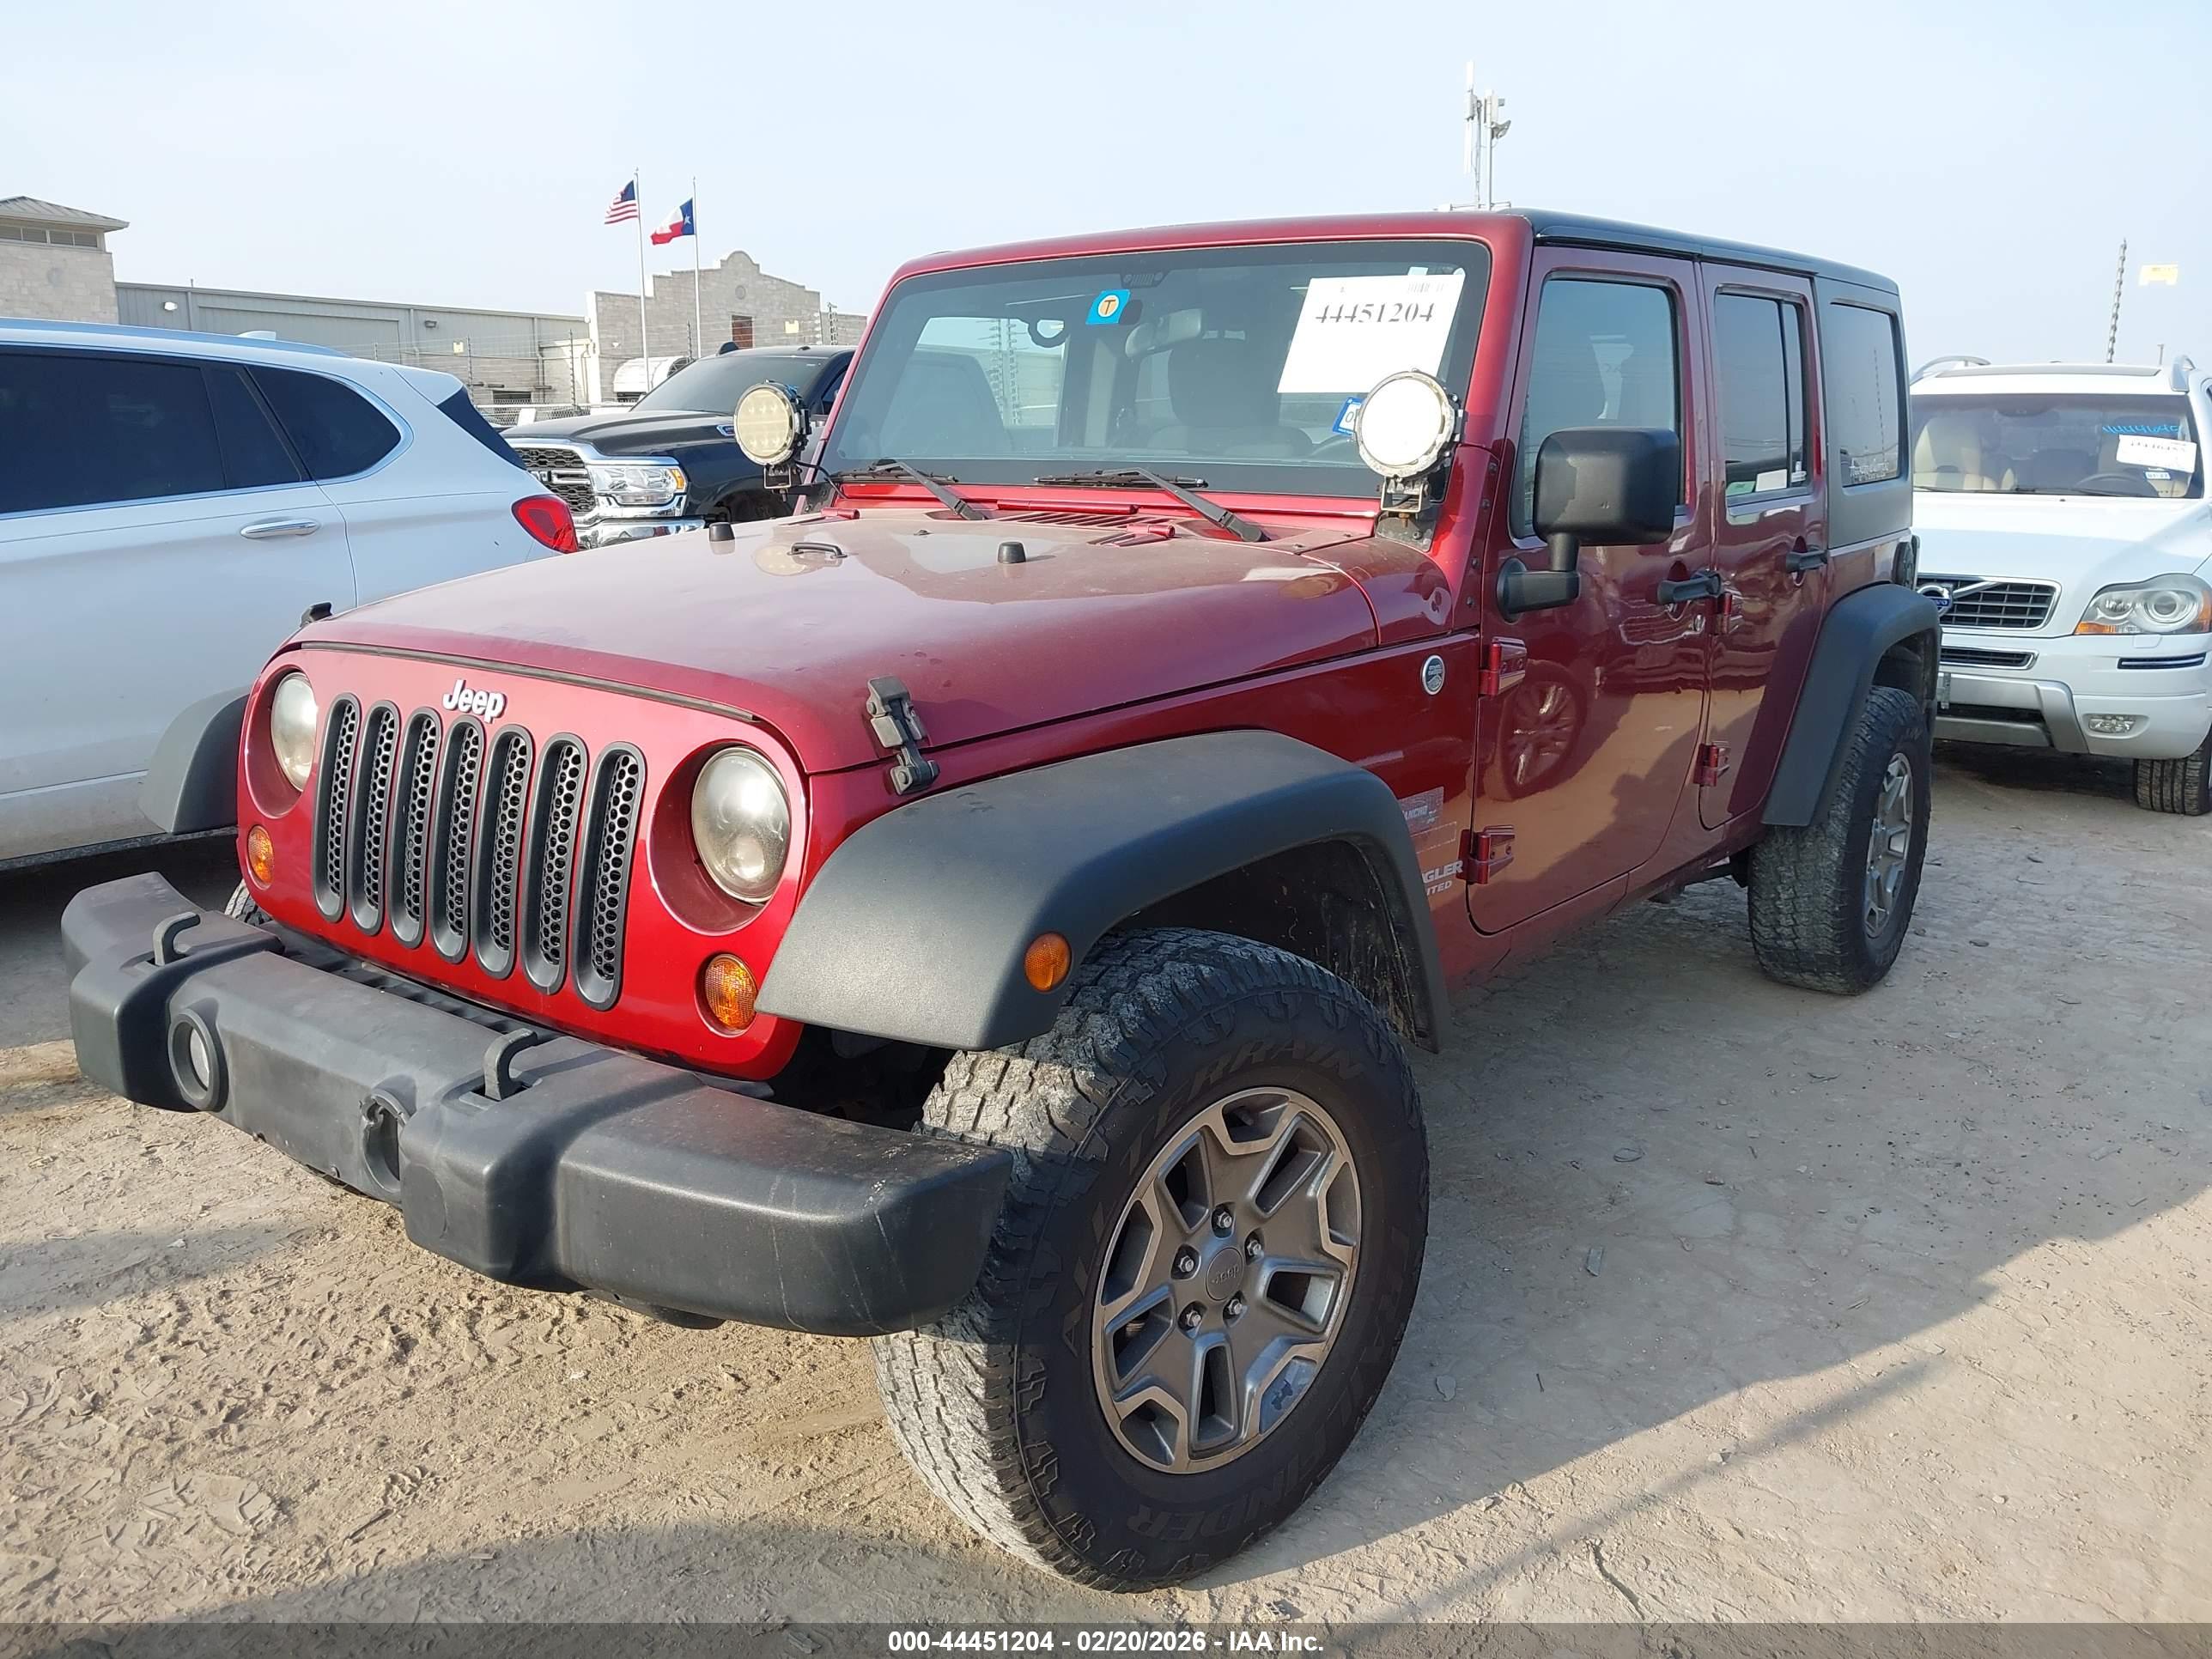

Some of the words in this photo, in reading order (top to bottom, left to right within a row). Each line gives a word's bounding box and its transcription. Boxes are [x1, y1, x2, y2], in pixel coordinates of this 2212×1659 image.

[1316, 302, 1435, 324] 44451204
[442, 678, 507, 725] Jeep
[1118, 1038, 1364, 1175] TERRAIN
